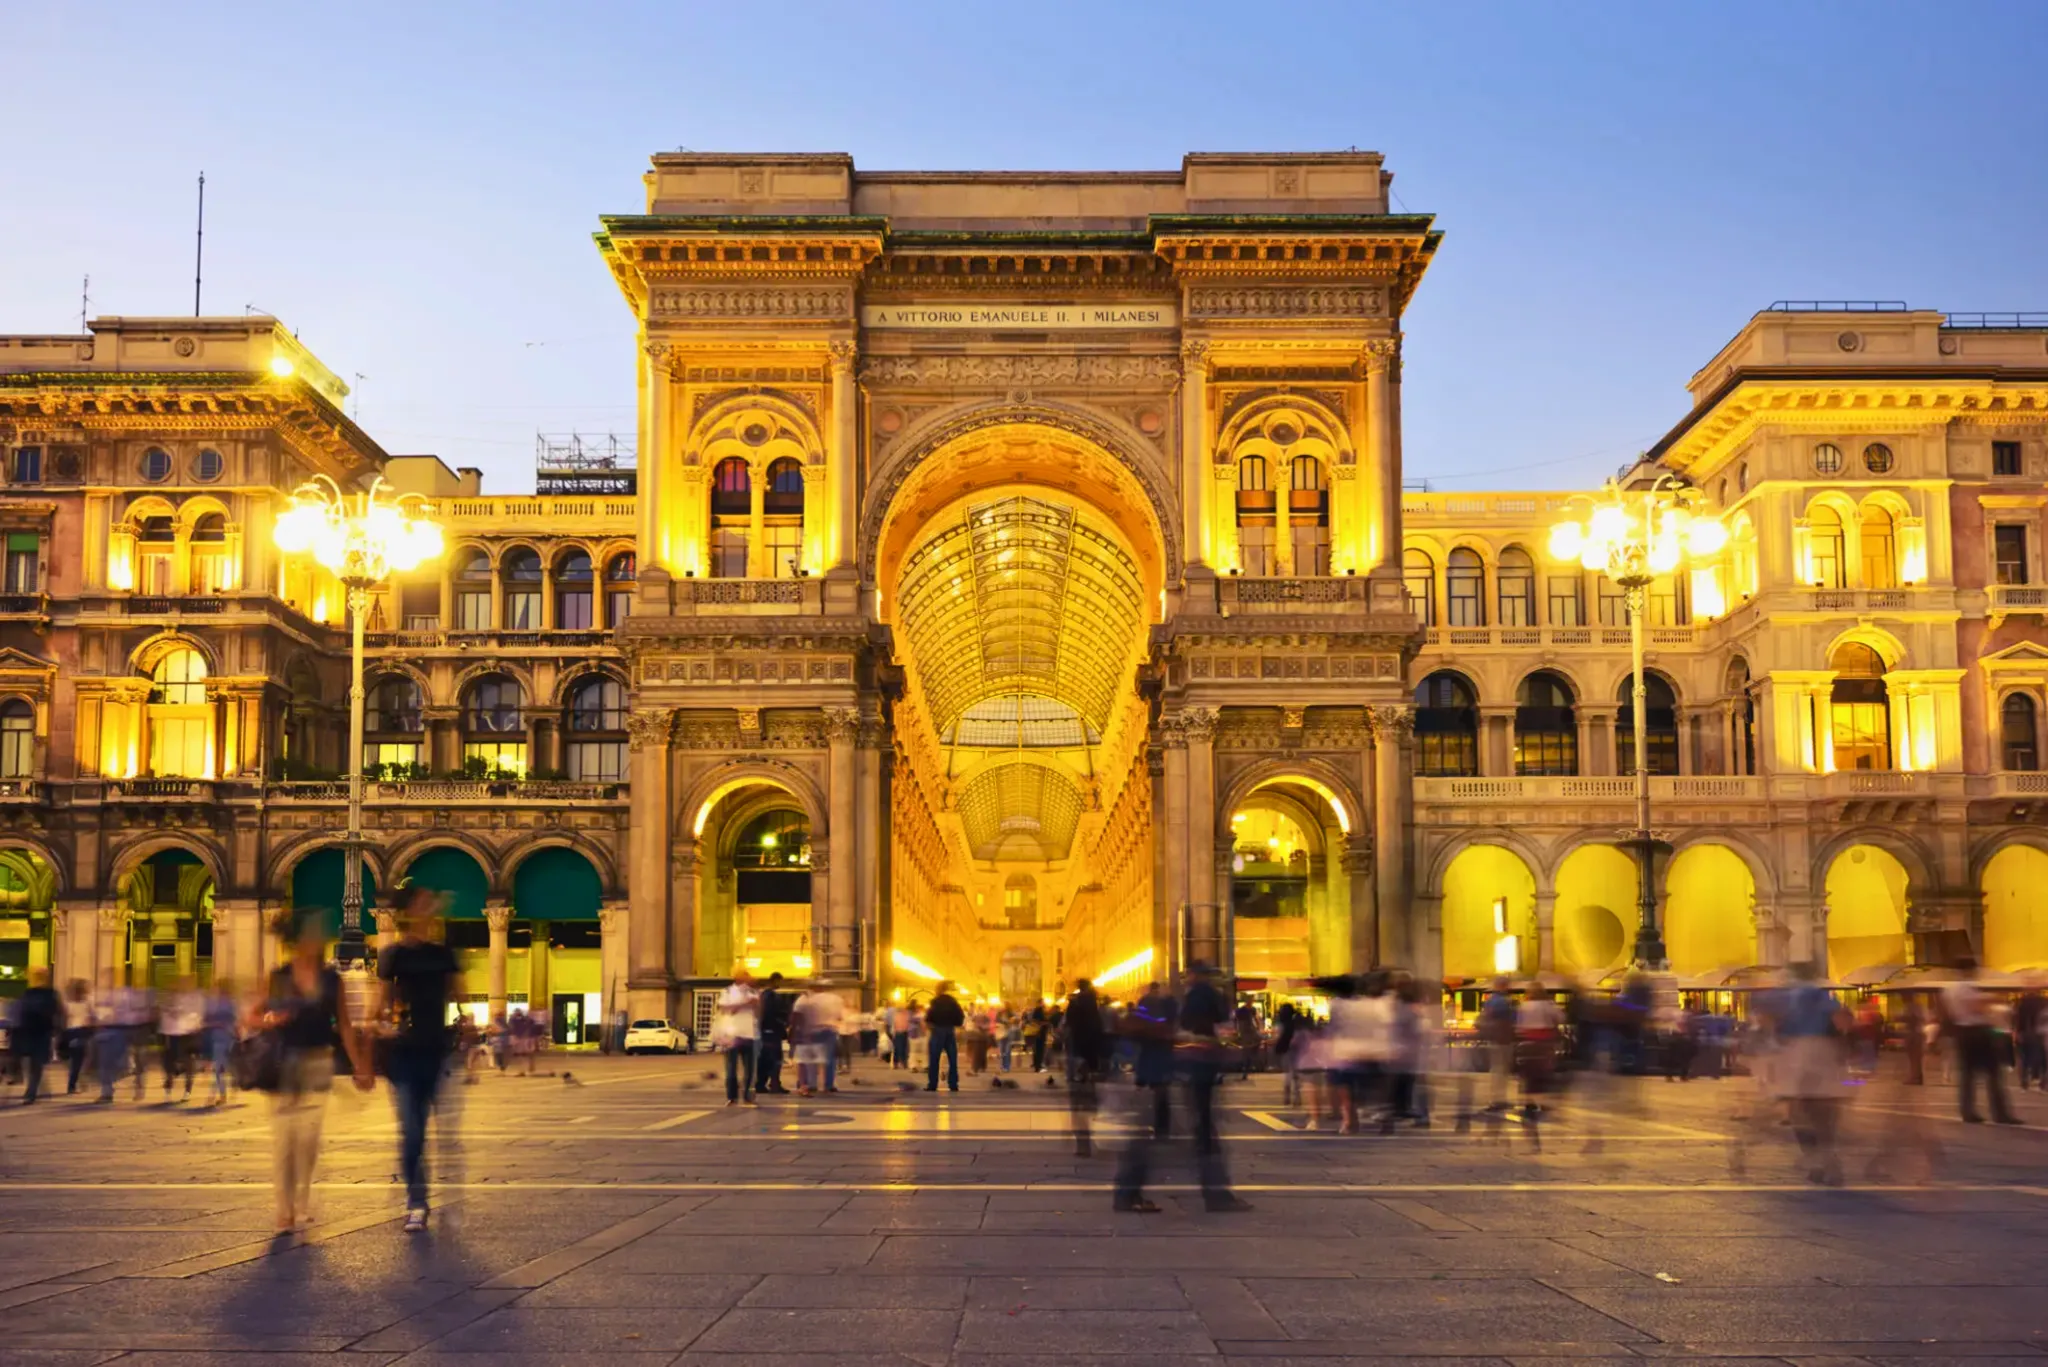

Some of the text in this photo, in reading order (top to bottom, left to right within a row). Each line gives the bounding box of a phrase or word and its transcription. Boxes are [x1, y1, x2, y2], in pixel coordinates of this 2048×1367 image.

[878, 311, 888, 322] A
[896, 311, 963, 322] VITTORIO
[970, 311, 1048, 322] EMANUELE
[1094, 311, 1159, 322] MILANESI
